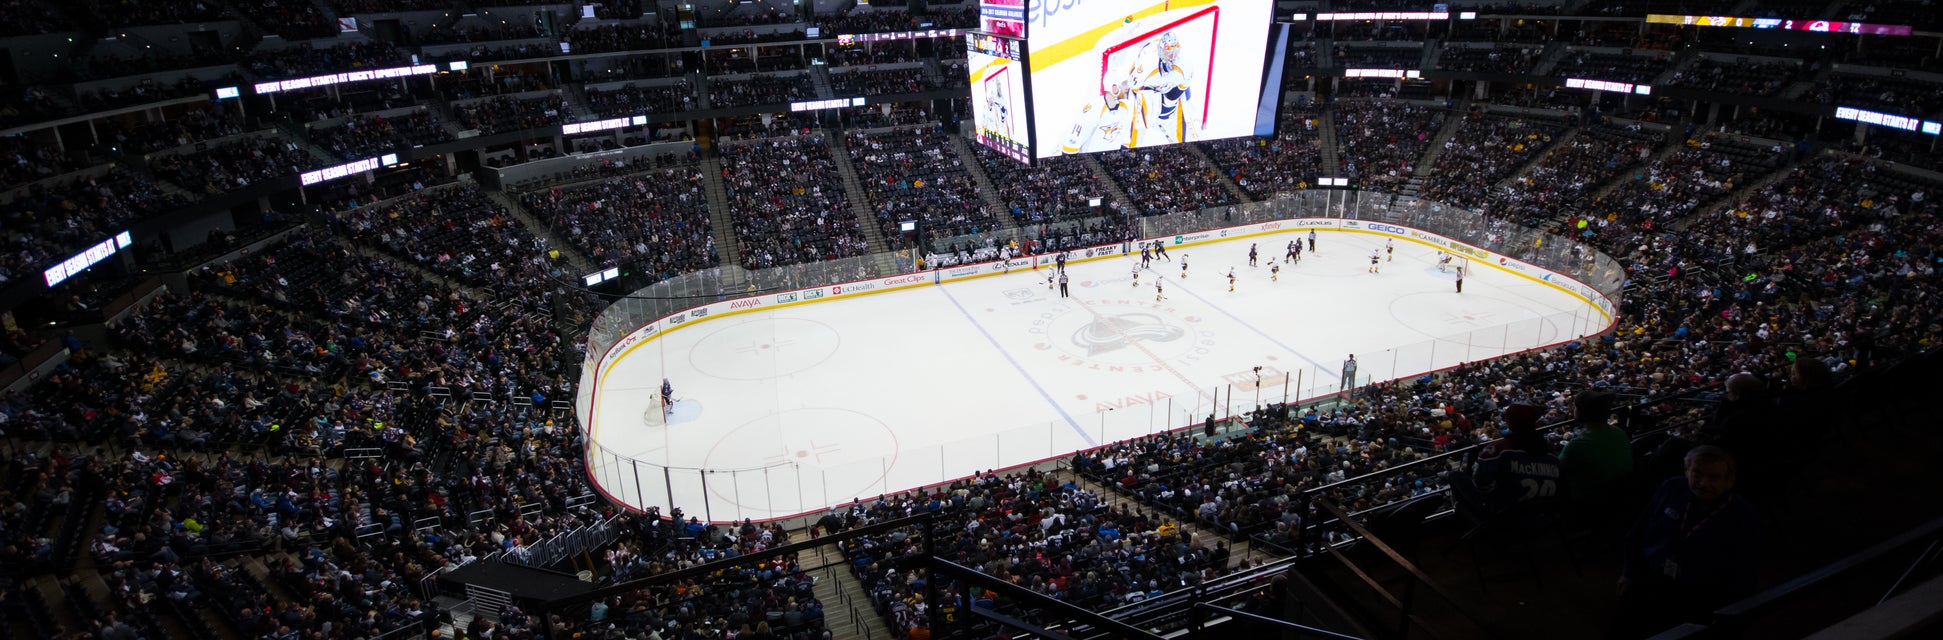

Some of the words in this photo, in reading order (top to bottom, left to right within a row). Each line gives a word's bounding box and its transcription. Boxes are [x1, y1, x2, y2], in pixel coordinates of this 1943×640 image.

[1027, 0, 1081, 28] ep
[1785, 20, 1793, 29] 2
[254, 81, 280, 94] EVERY
[280, 78, 311, 90] SEASON
[311, 74, 339, 87] STARTS
[338, 73, 348, 83] AT
[374, 67, 412, 78] SPORTING
[1836, 106, 1859, 120] EVERY
[1858, 110, 1883, 125] SEASON
[1882, 114, 1909, 129] STARTS
[1907, 118, 1919, 131] AT
[562, 123, 580, 134] EVERY
[1072, 124, 1082, 137] 14
[300, 170, 322, 186] EVERY
[322, 165, 348, 180] SEASON
[347, 159, 370, 174] STARTS
[370, 158, 378, 169] AT
[1261, 222, 1281, 231] xfinity
[1368, 223, 1405, 235] GEICO
[1419, 232, 1446, 246] CAMBRIA
[44, 262, 67, 287] EVERY
[63, 251, 90, 277] SEASON
[85, 241, 109, 266] STARTS
[105, 238, 116, 255] AT
[1508, 261, 1525, 270] pepsi
[884, 277, 904, 286] Great
[906, 274, 925, 284] Clips
[842, 282, 875, 293] UCHealth
[730, 298, 761, 309] AVAYA
[1095, 390, 1175, 414] AVAYA
